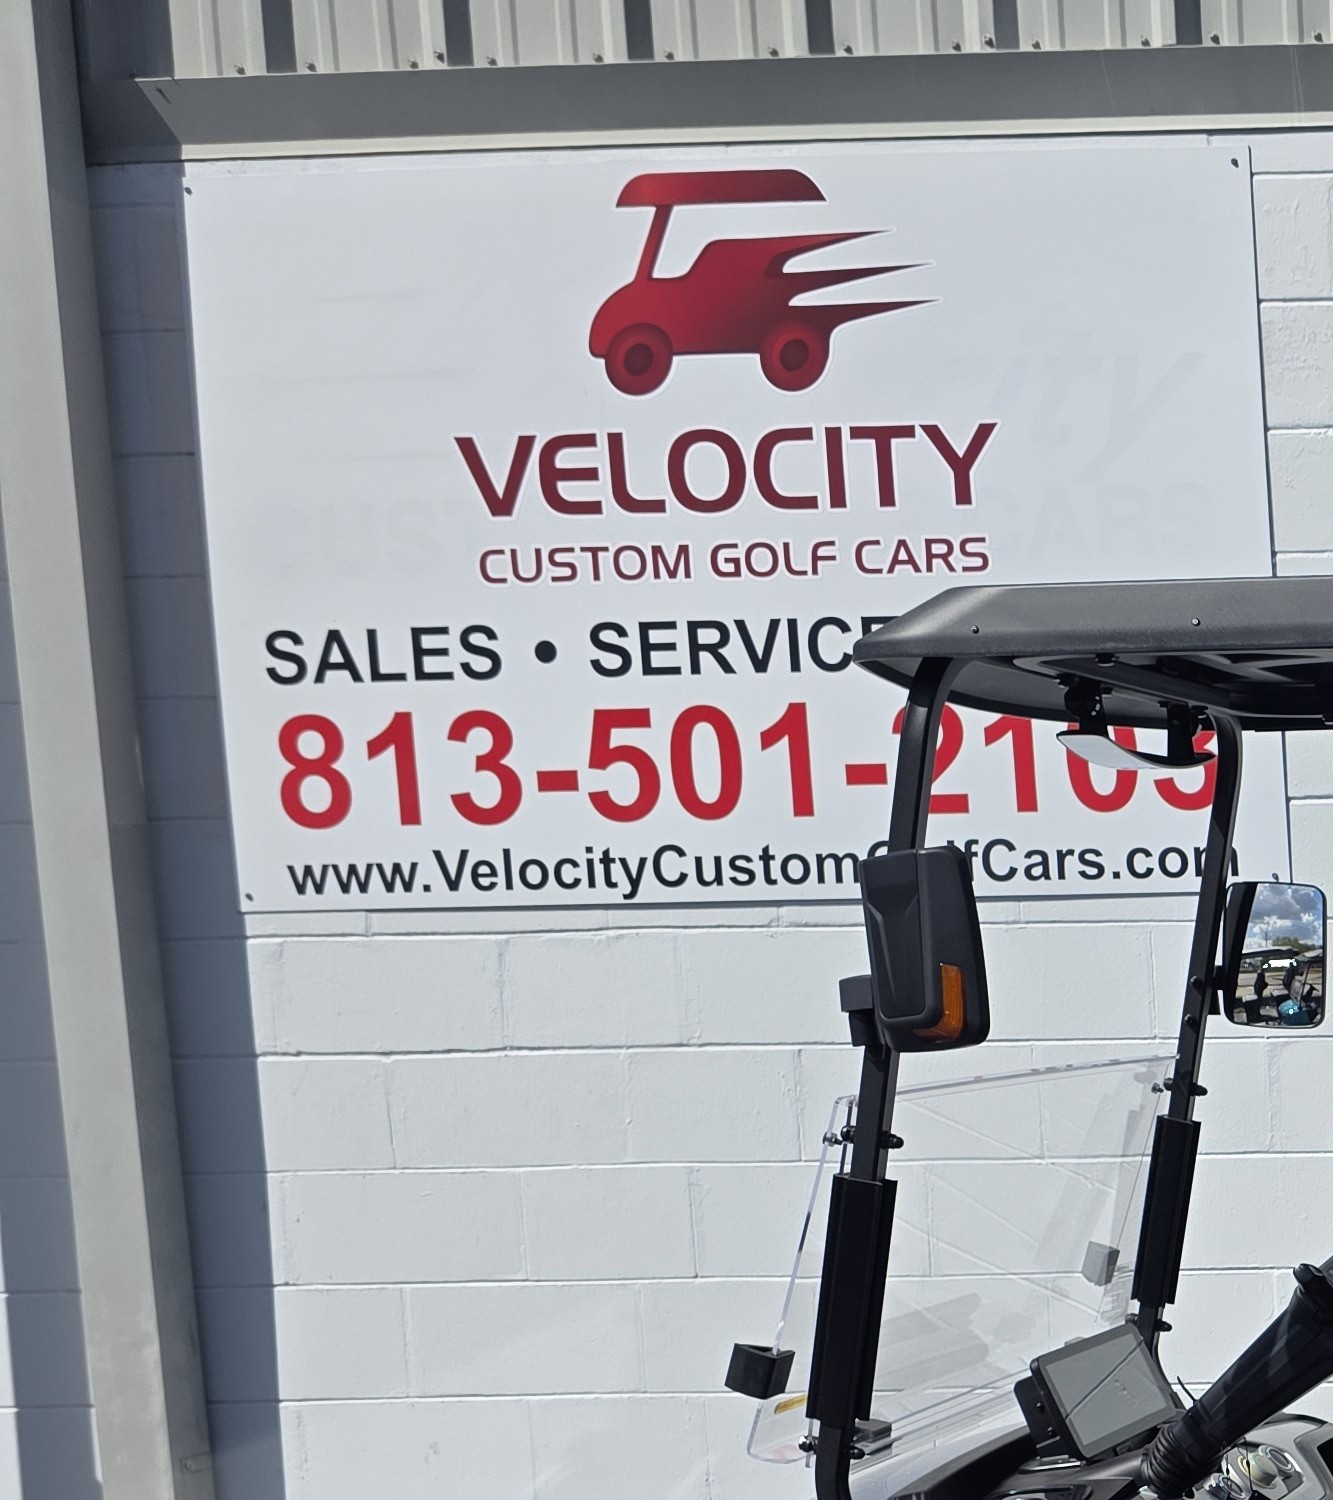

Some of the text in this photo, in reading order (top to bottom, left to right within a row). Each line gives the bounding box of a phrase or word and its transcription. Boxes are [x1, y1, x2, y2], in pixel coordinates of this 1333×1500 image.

[454, 422, 997, 518] VELOCITY
[478, 536, 990, 585] CUSTOM GOLF CARS
[264, 624, 503, 686] SALES
